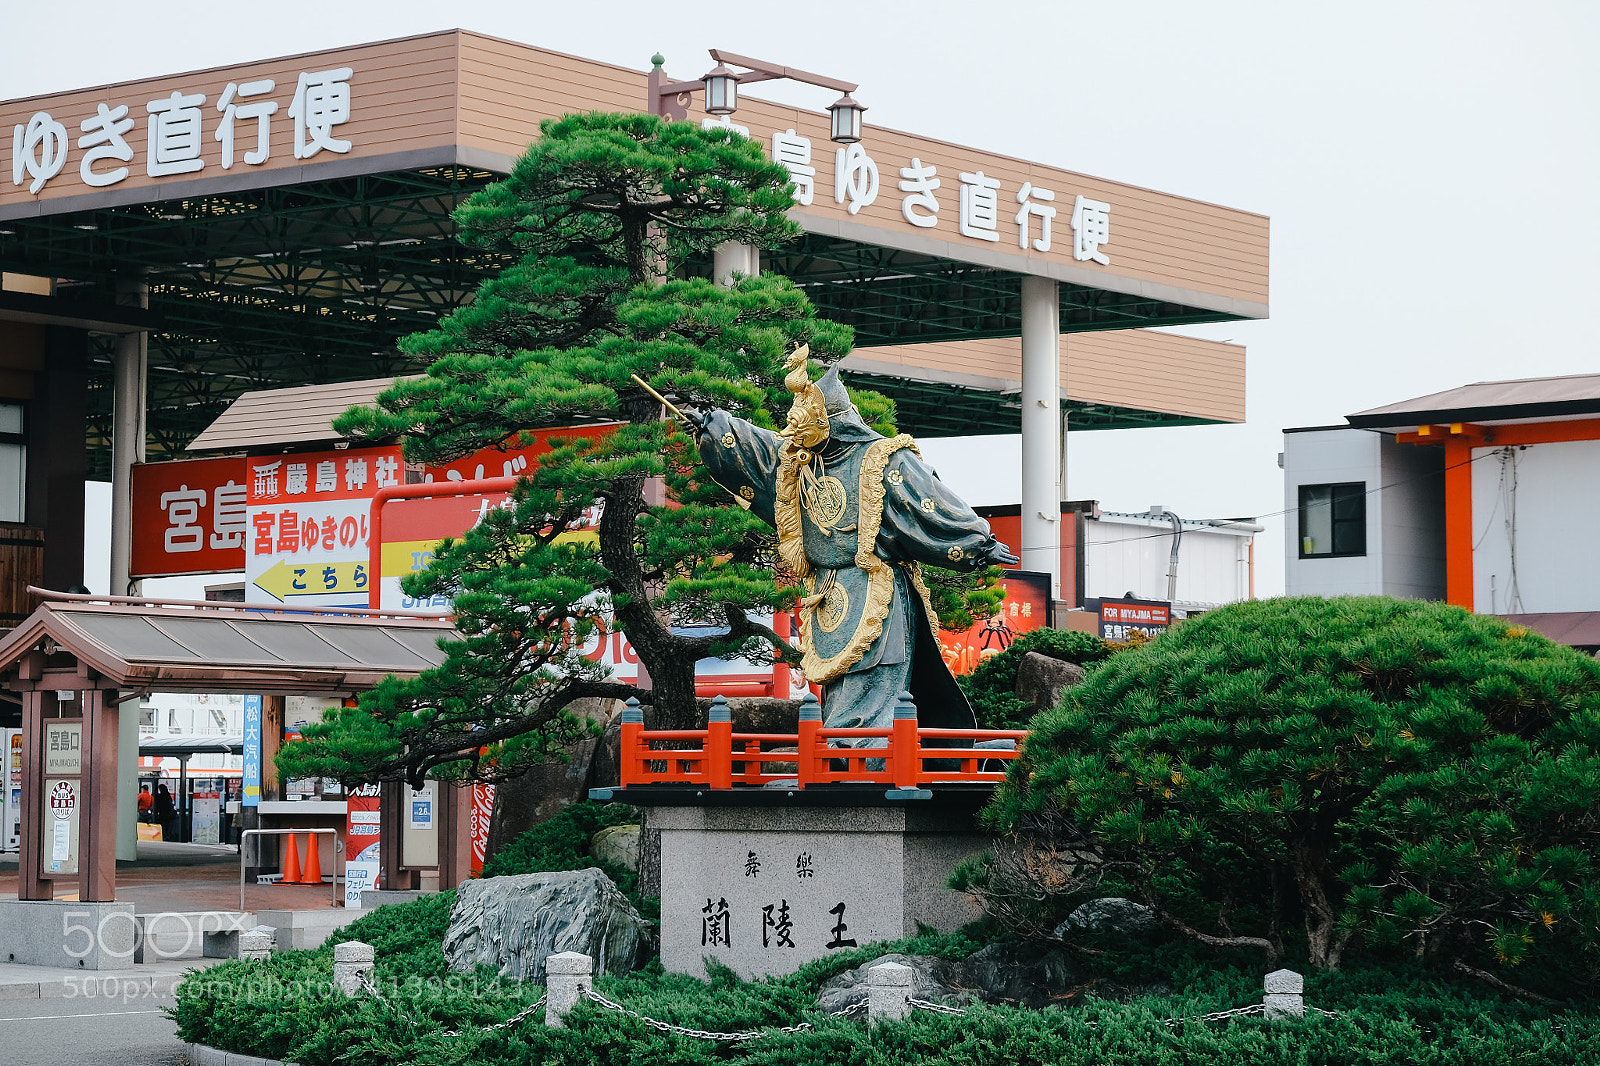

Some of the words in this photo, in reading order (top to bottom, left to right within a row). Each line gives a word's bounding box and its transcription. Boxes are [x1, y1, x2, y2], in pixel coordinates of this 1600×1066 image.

[13, 66, 354, 195] ゆき直行便
[701, 115, 1111, 266] 島ゆき直行便
[292, 564, 368, 590] こちら
[1104, 607, 1118, 618] FOR
[1120, 608, 1151, 620] MIYAJIMA
[50, 730, 80, 751] 宮島口
[347, 880, 372, 890] フェリー
[701, 897, 858, 949] 蘭陵王
